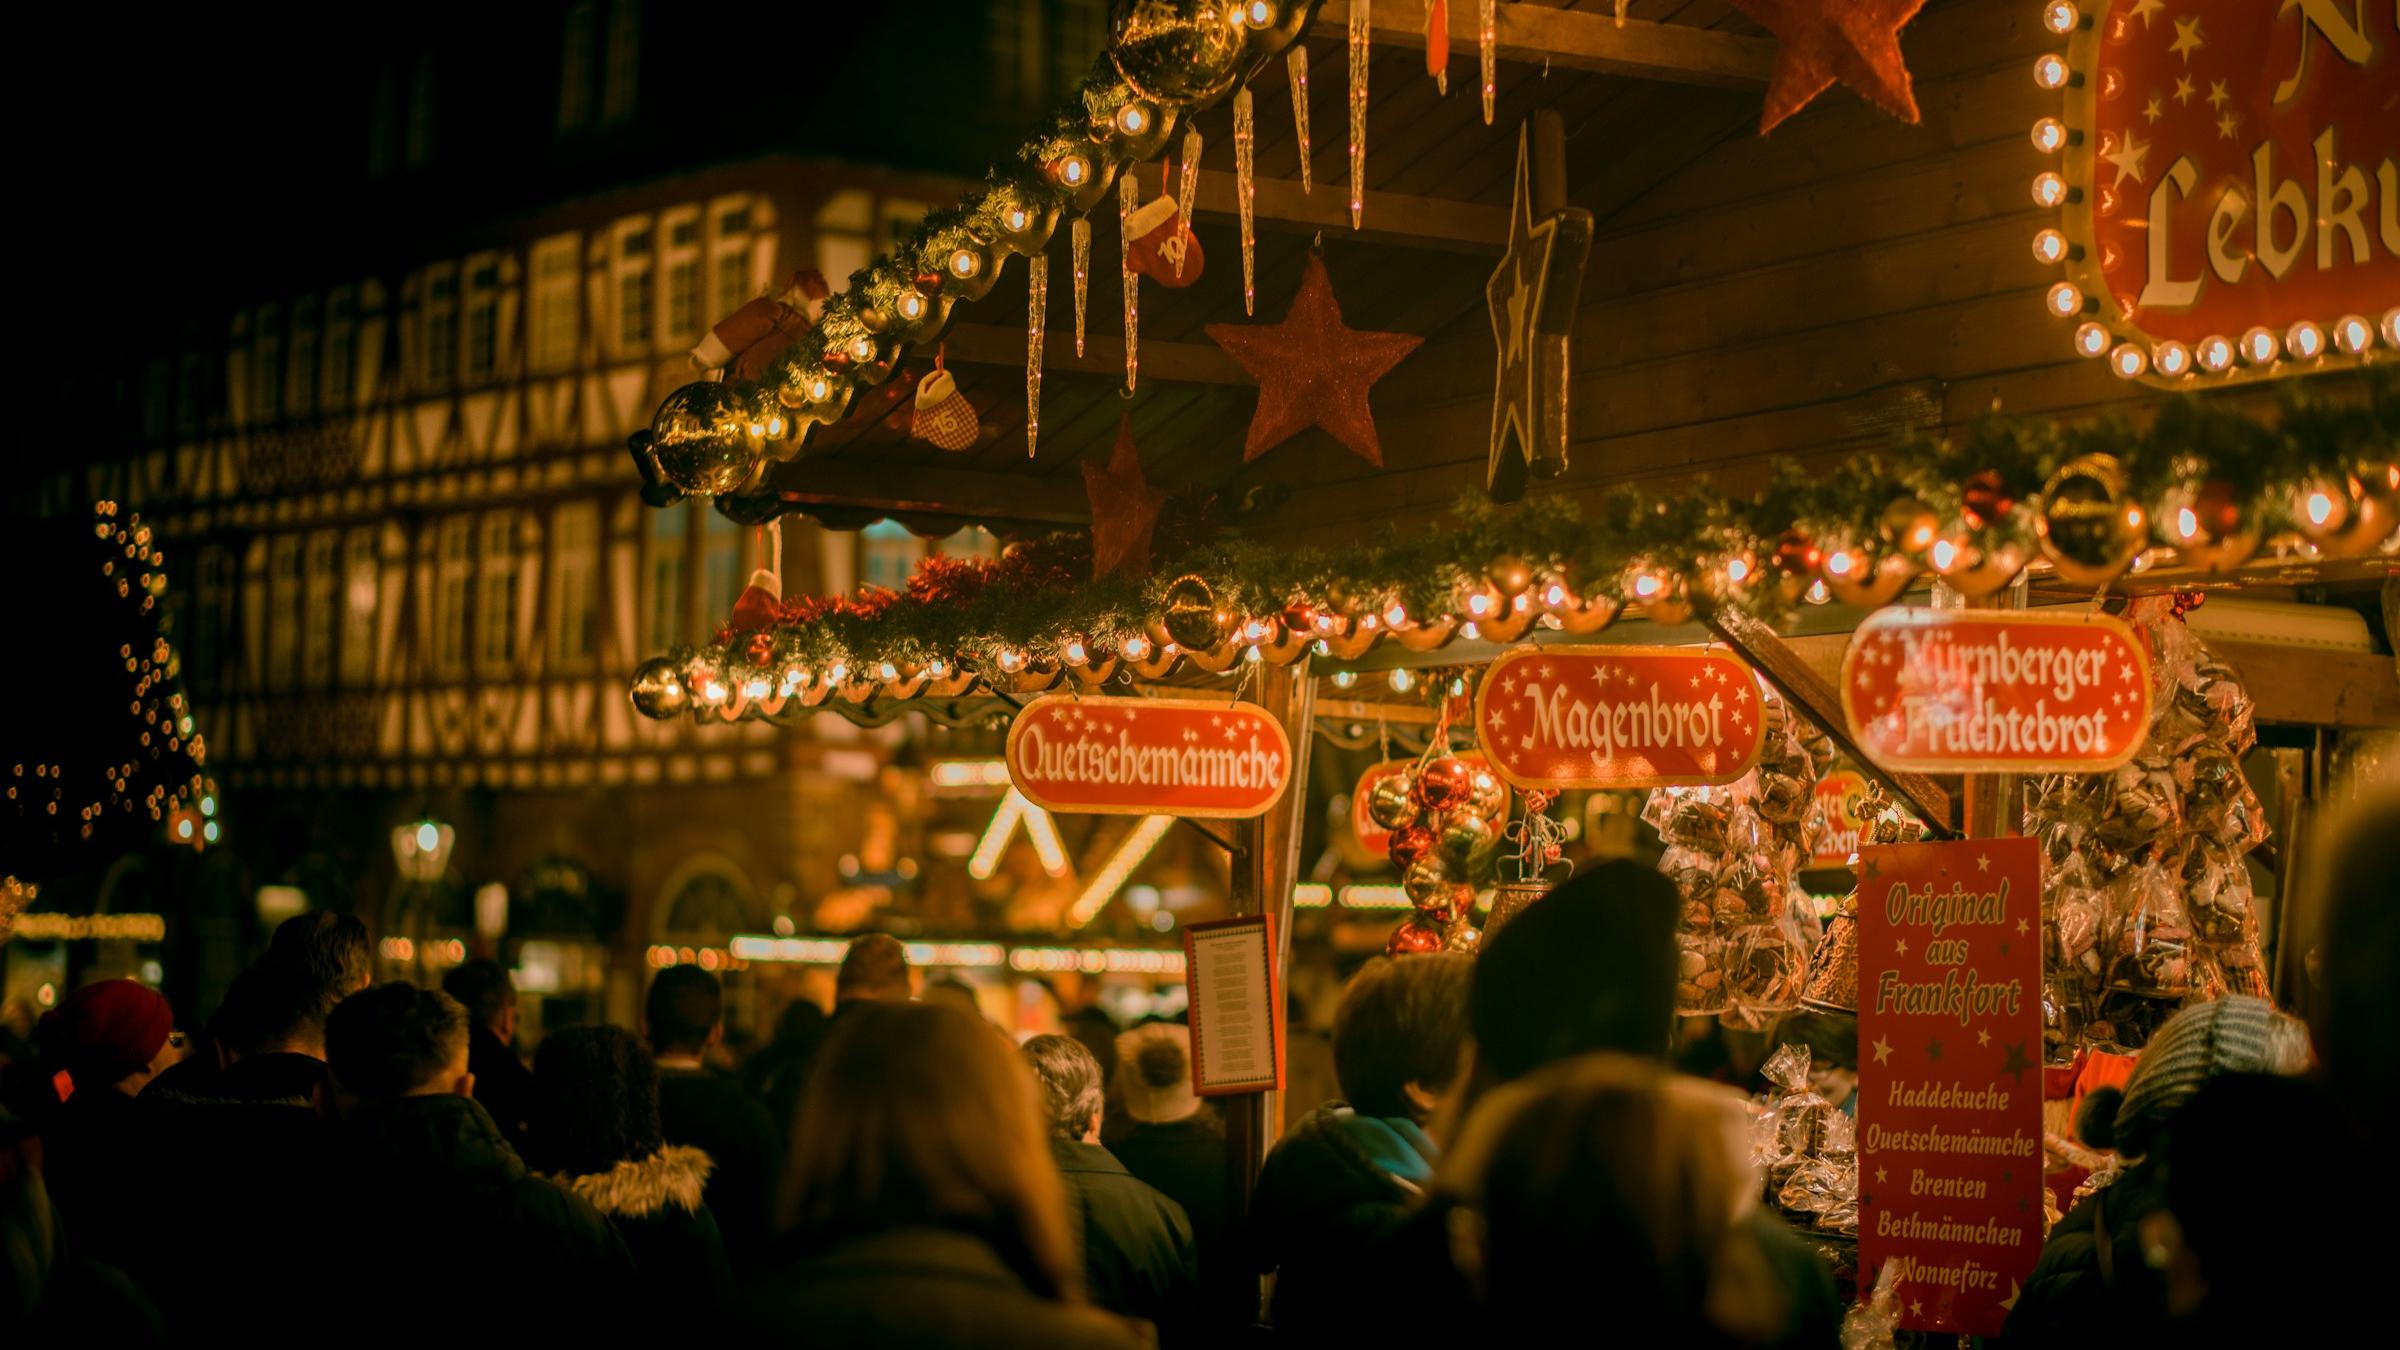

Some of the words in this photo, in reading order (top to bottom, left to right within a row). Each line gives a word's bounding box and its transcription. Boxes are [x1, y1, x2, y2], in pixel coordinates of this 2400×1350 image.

[1896, 628, 2107, 702] Nürnberger
[1520, 681, 1724, 768] Magenbrot
[1018, 722, 1281, 789] Quetschemännche
[1885, 875, 2011, 938] Original
[1924, 939, 1970, 966] aus
[1875, 968, 2023, 1028] Frankfort
[1887, 1080, 2010, 1111] Haddekuche
[1864, 1123, 2036, 1157] Quetschemännche
[1910, 1168, 1987, 1199] Brenten
[1876, 1210, 2023, 1247] Bethmännchen
[1902, 1255, 1999, 1294] Nonneförz
